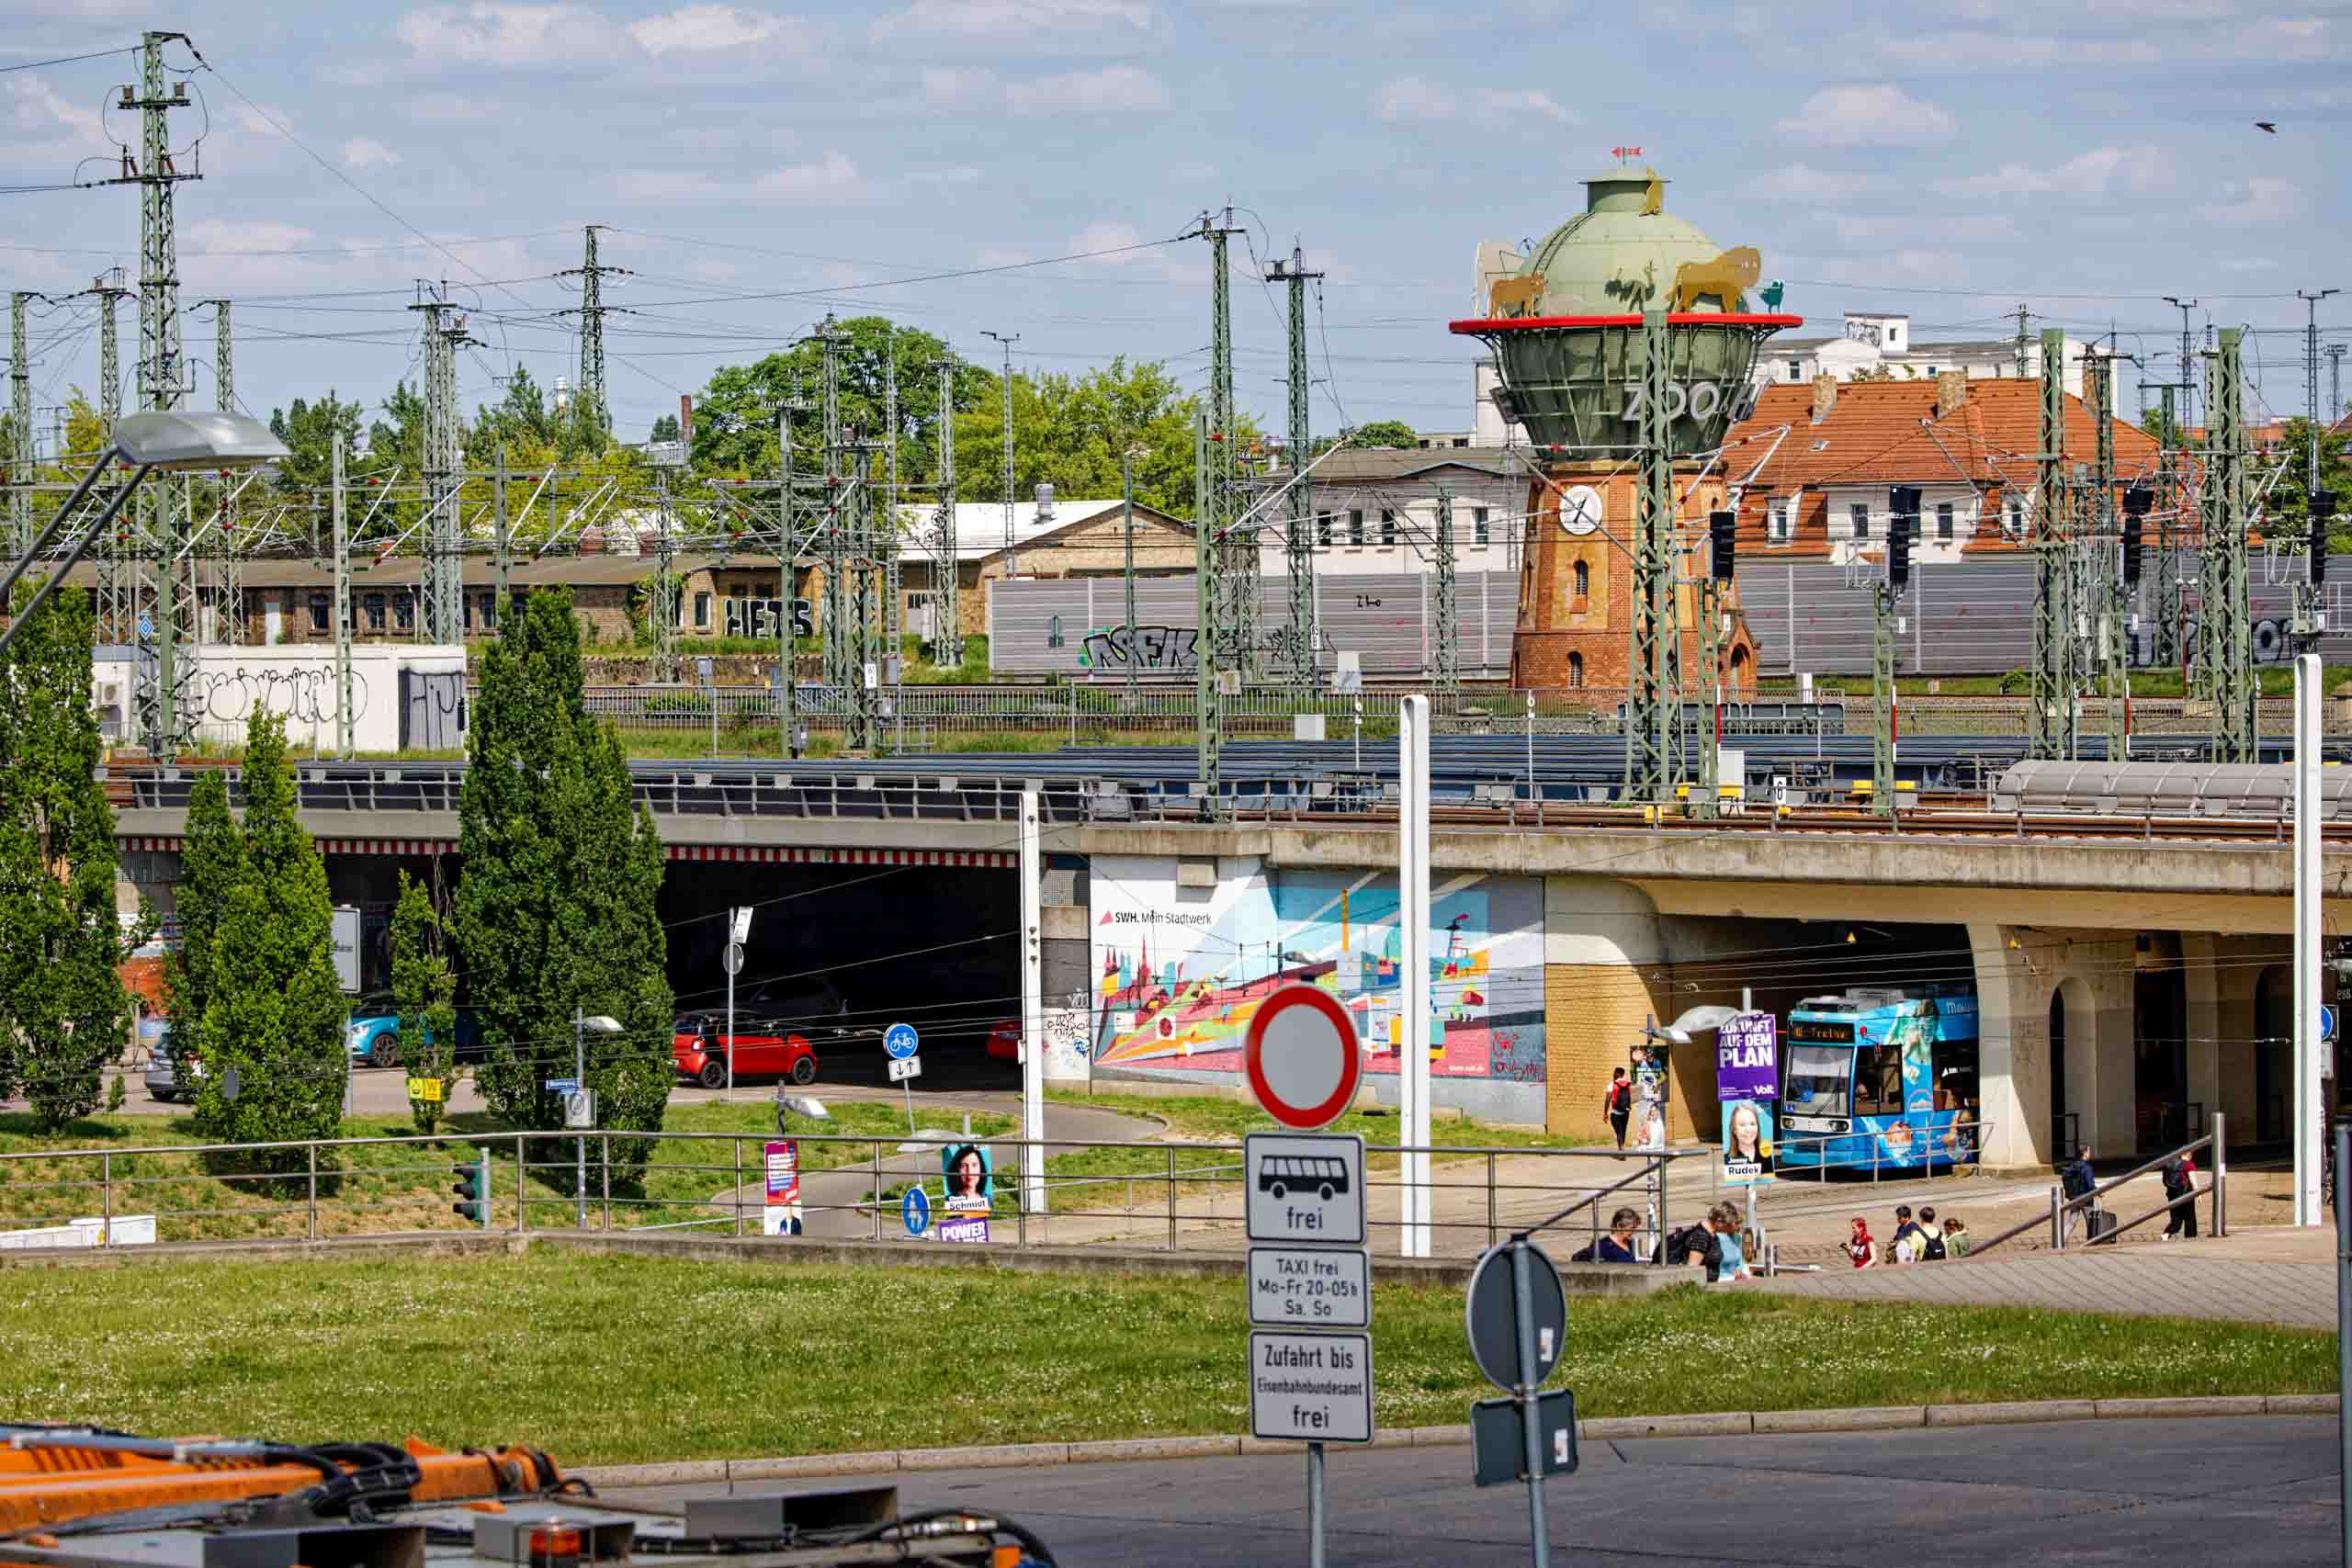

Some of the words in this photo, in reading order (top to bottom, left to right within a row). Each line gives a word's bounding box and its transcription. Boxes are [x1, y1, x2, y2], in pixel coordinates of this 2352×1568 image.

[1622, 382, 1720, 421] ZOO
[1115, 912, 1139, 922] SWH.
[1141, 911, 1163, 923] Mein
[1165, 912, 1212, 925] Stadtwerk
[1720, 1034, 1743, 1047] AUF
[1745, 1033, 1772, 1046] DEM
[1719, 1046, 1773, 1068] PLAN
[1753, 1084, 1775, 1095] Volt
[1727, 1166, 1759, 1176] Rudek
[948, 1200, 986, 1212] Schmidt
[1286, 1206, 1323, 1229] frei
[941, 1222, 986, 1242] POWER
[1276, 1258, 1308, 1274] TAXI
[1314, 1260, 1339, 1275] frei
[1258, 1279, 1303, 1294] Mo-Fr
[1313, 1301, 1331, 1315] So
[1264, 1345, 1322, 1367] Zufahrt
[1330, 1347, 1353, 1369] bis
[1257, 1378, 1363, 1395] Eisenbahnbundesamt
[1294, 1404, 1329, 1428] frei
